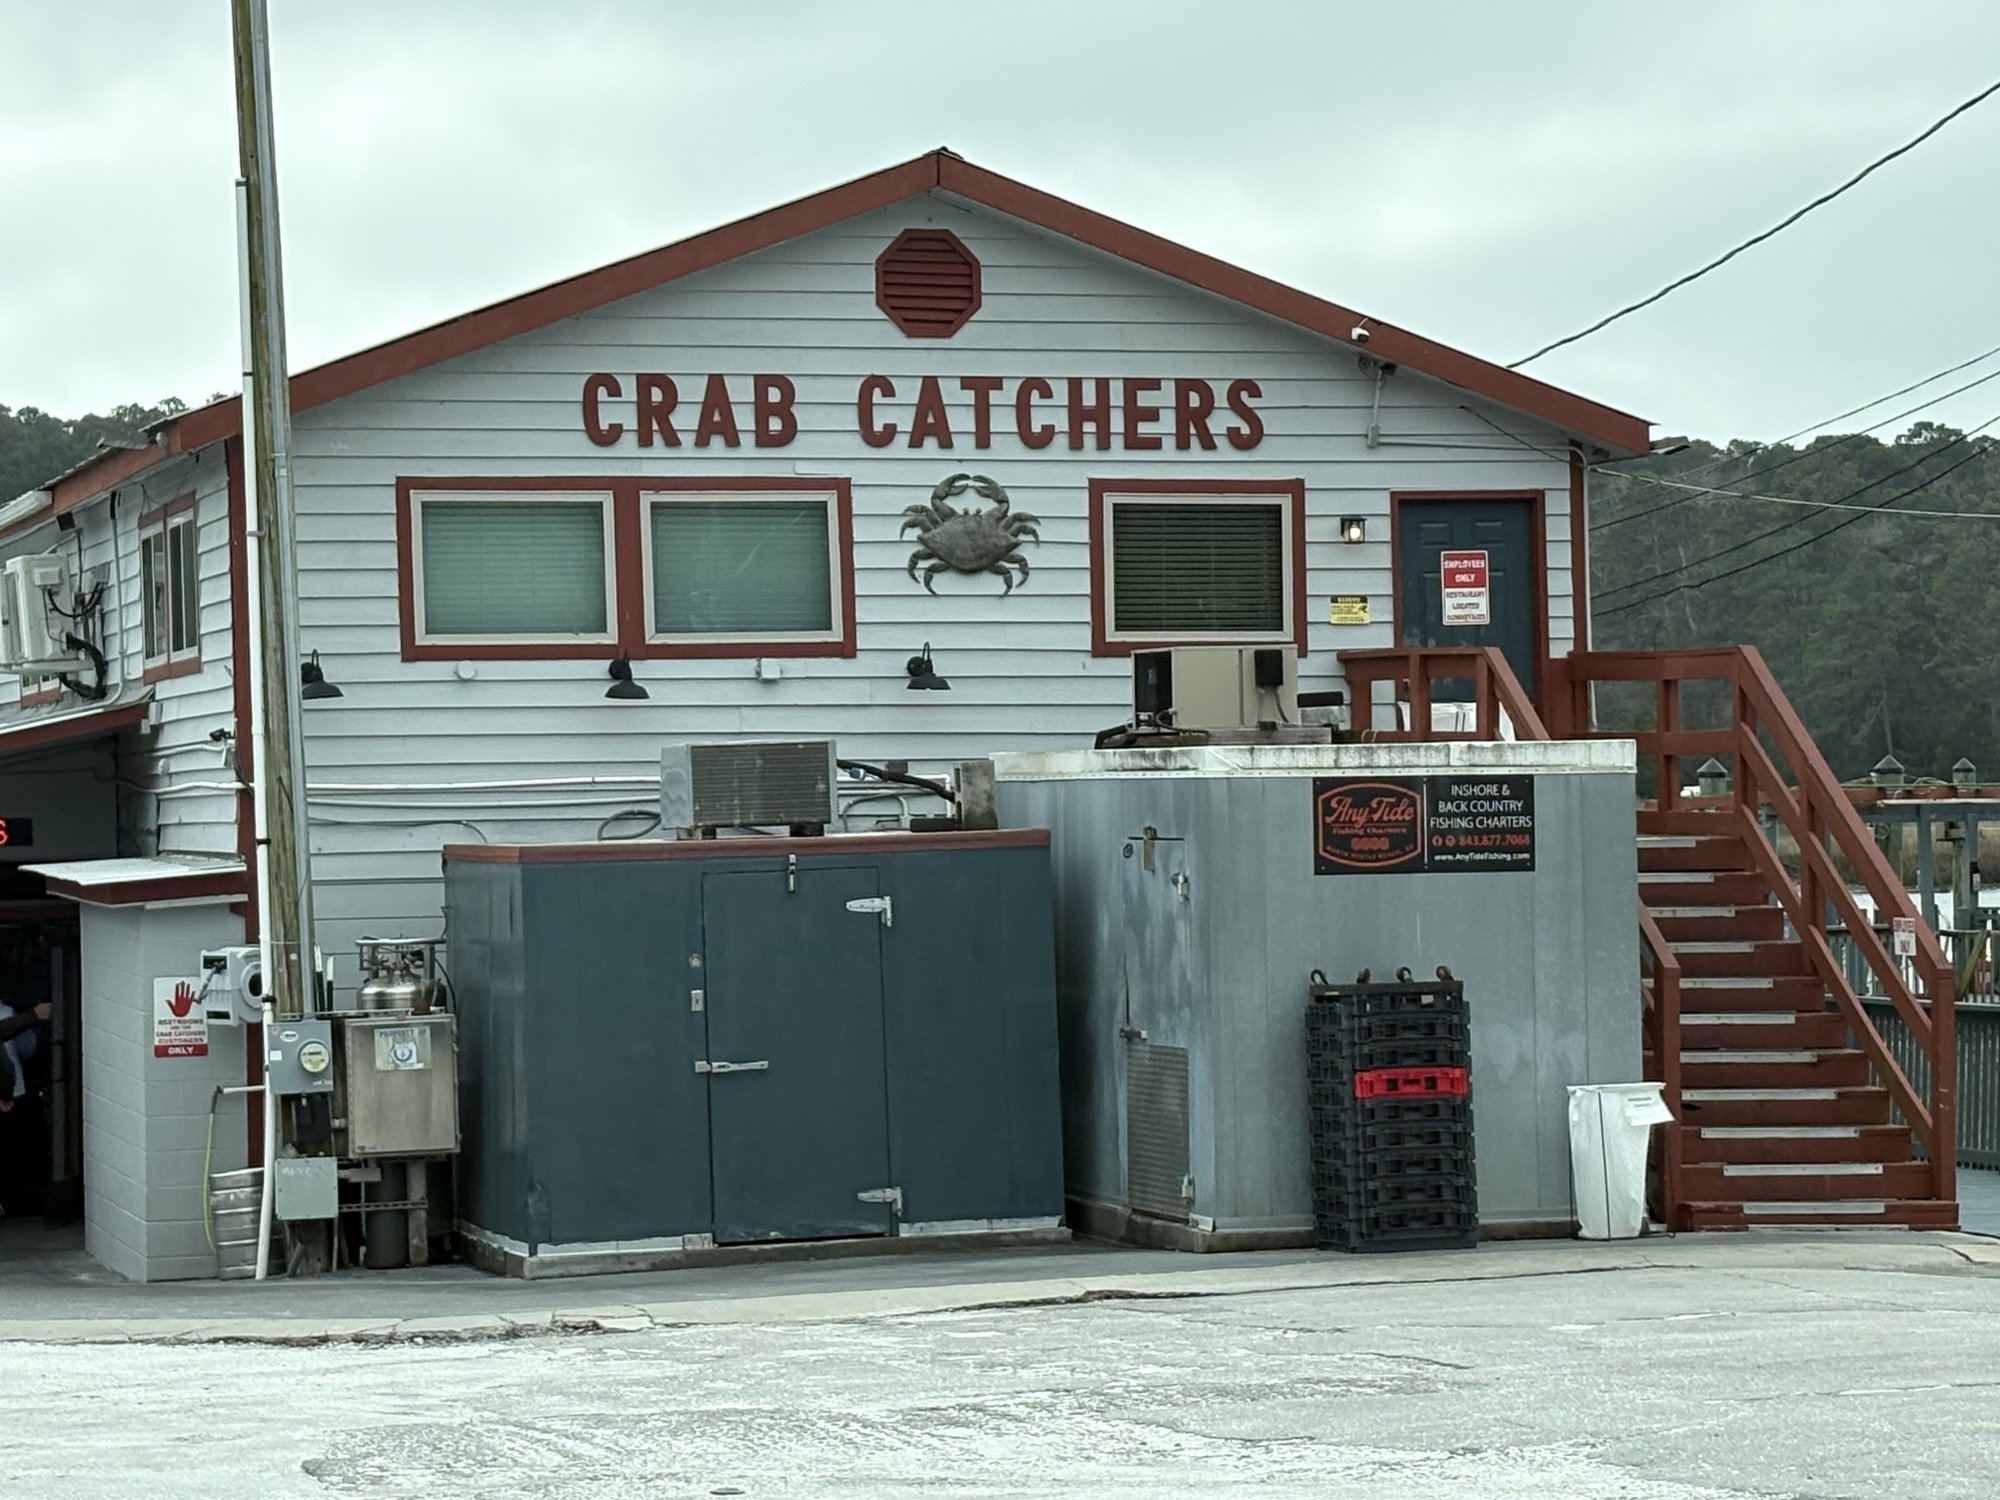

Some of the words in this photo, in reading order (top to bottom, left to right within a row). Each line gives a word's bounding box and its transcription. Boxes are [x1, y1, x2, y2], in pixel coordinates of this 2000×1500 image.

[583, 373, 798, 447] CRAB
[857, 373, 1264, 450] CATCHERS
[1444, 560, 1485, 569] EMPLOYEES
[1455, 573, 1475, 583] ONLY
[1451, 784, 1500, 797] INSHORE
[1501, 784, 1511, 796] &
[1325, 796, 1369, 828] Any
[1371, 796, 1414, 822] Tide
[1438, 800, 1468, 813] BACK
[1470, 800, 1523, 813] COUNTRY
[1430, 816, 1474, 829] FISHING
[1476, 815, 1533, 828] CHARTERS
[379, 1029, 415, 1038] PROPERTY
[167, 1046, 195, 1055] ONLY
